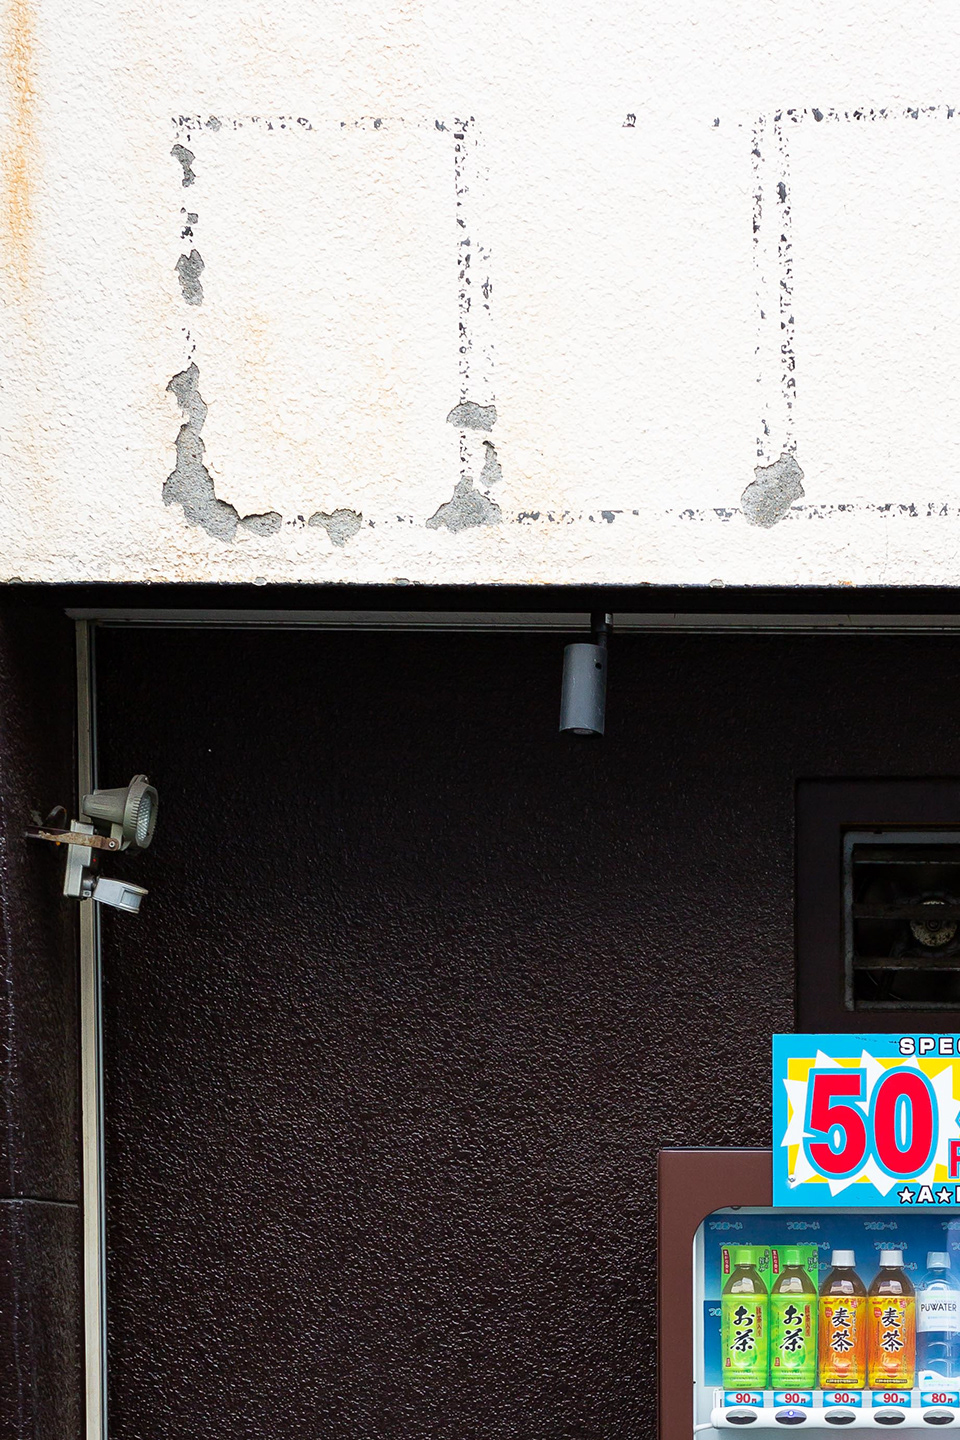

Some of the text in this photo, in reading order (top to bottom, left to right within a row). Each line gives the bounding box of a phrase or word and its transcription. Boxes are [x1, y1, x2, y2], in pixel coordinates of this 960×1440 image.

[730, 1305, 755, 1352] お茶
[779, 1304, 804, 1352] お茶
[831, 1307, 854, 1352] 麦茶
[880, 1307, 904, 1352] 麦茶
[920, 1303, 957, 1312] PUWATER
